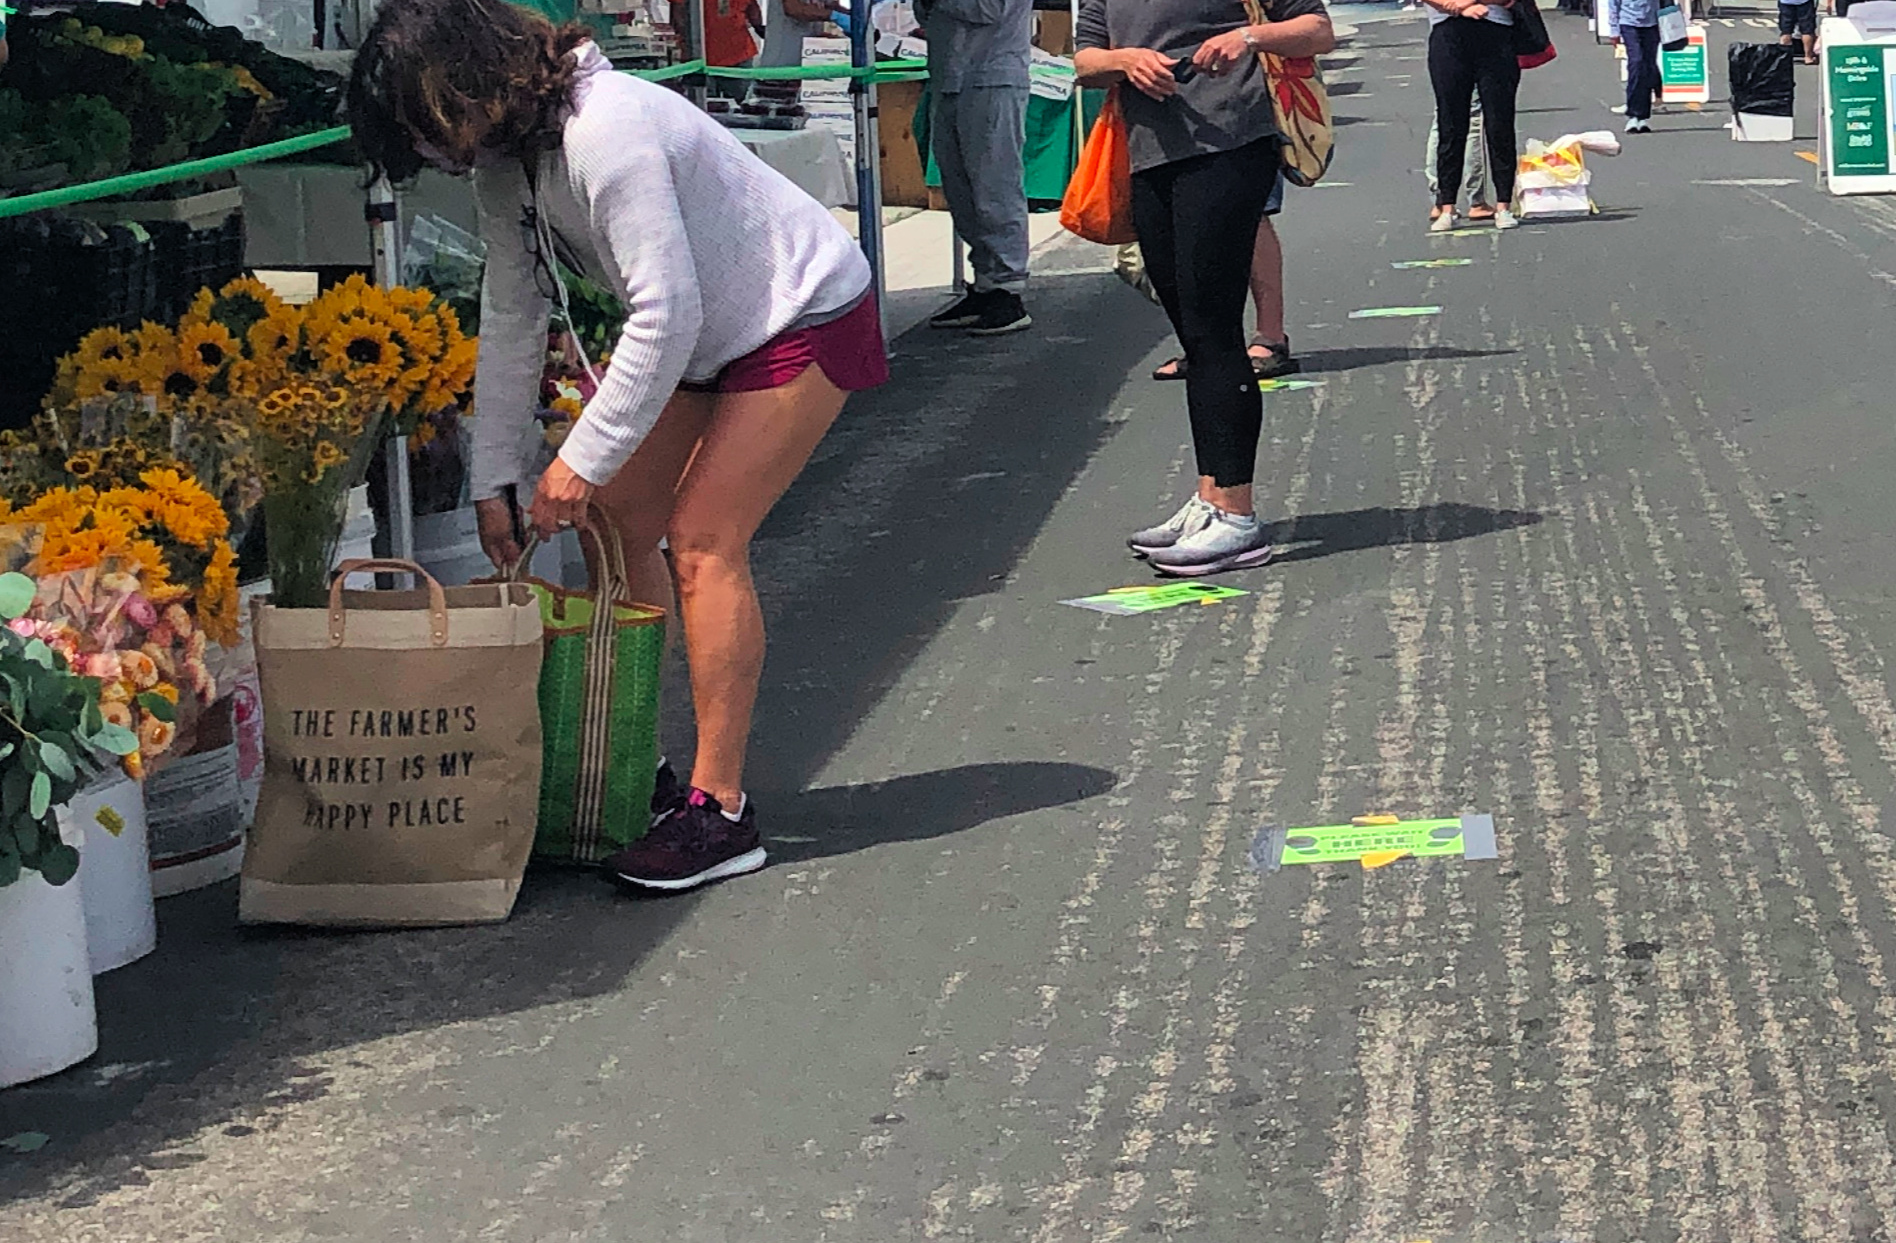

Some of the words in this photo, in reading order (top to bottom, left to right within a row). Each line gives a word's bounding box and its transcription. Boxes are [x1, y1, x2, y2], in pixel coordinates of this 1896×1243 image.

[292, 710, 336, 737] THE
[350, 706, 476, 737] FARMER'S
[292, 757, 385, 784] MARKET
[402, 755, 425, 781] IS
[439, 751, 474, 777] MY
[302, 800, 373, 830] HAPPY
[388, 796, 466, 828] PLACE
[1332, 836, 1413, 848] HERE
